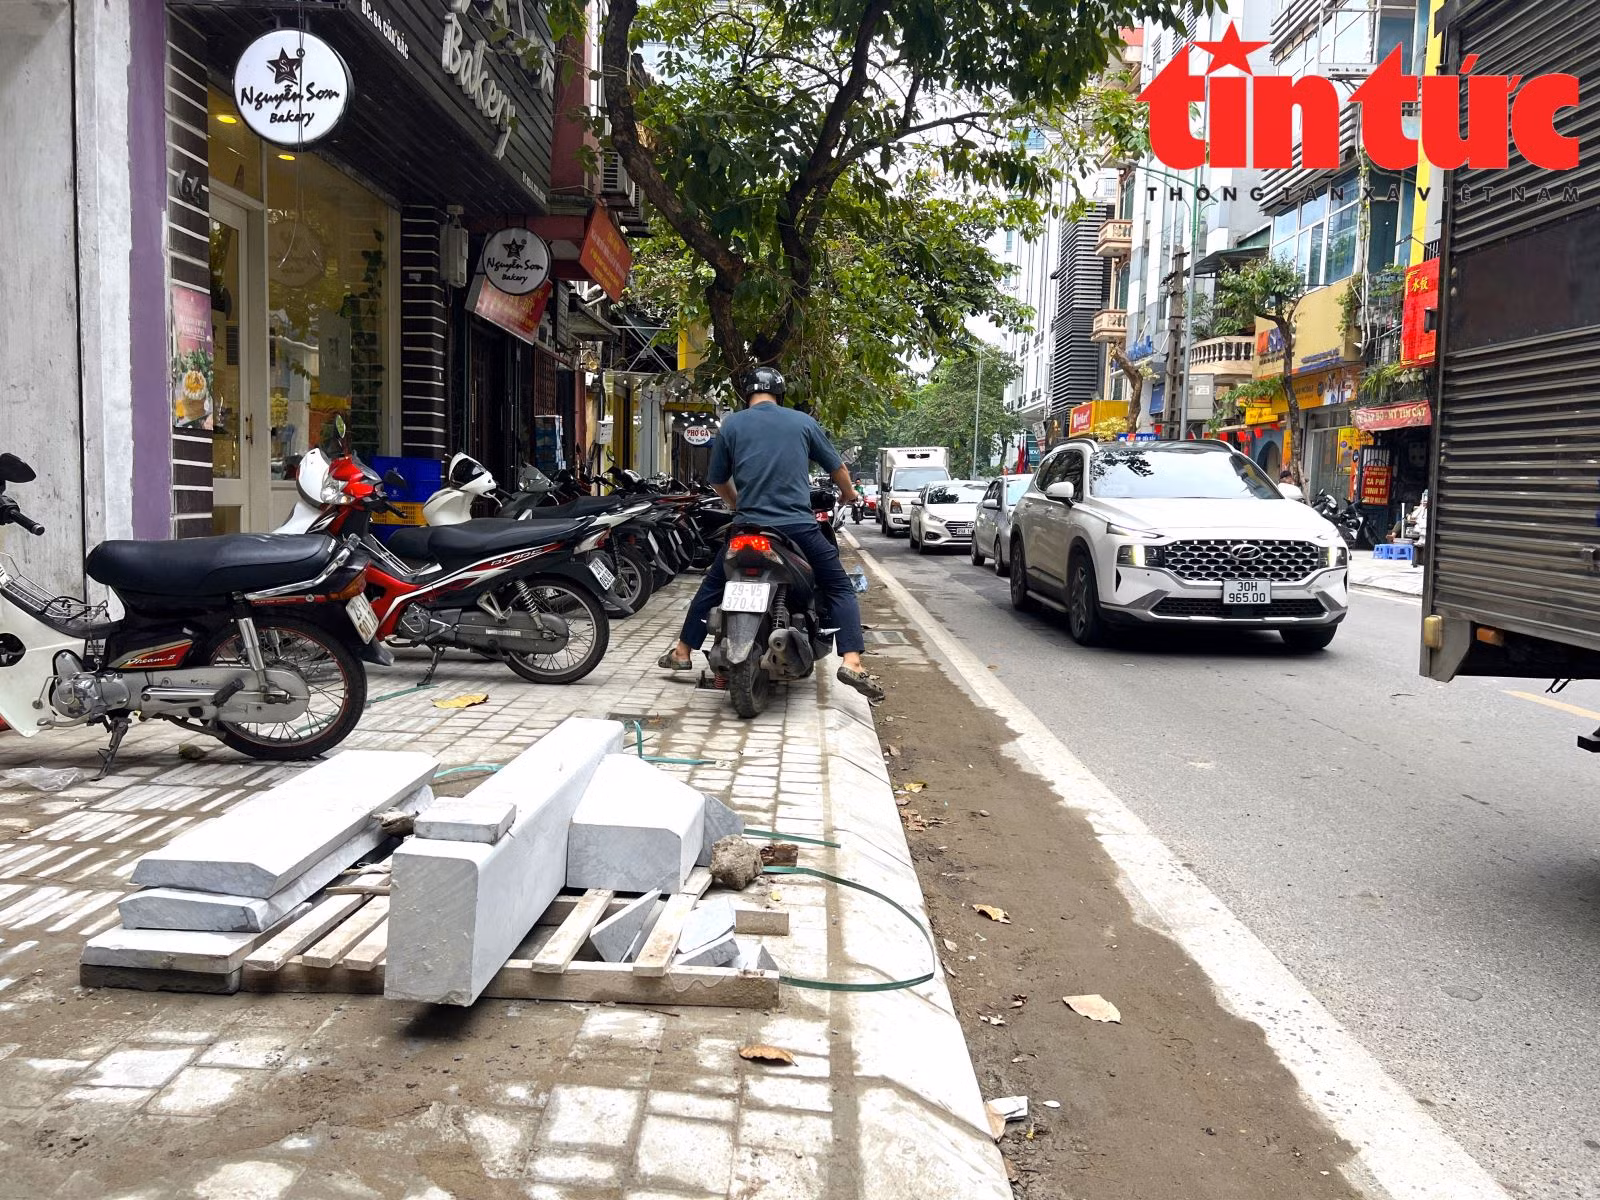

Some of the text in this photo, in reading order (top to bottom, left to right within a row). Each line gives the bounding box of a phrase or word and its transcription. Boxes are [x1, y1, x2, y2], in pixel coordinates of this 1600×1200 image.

[373, 10, 382, 31] 64
[441, 12, 515, 160] Bakery
[269, 109, 315, 128] Bakery
[501, 273, 528, 285] Bakery
[731, 584, 763, 597] 29-V5
[1237, 581, 1258, 592] 30H
[725, 596, 764, 611] 370.41
[1228, 592, 1266, 603] 965.00
